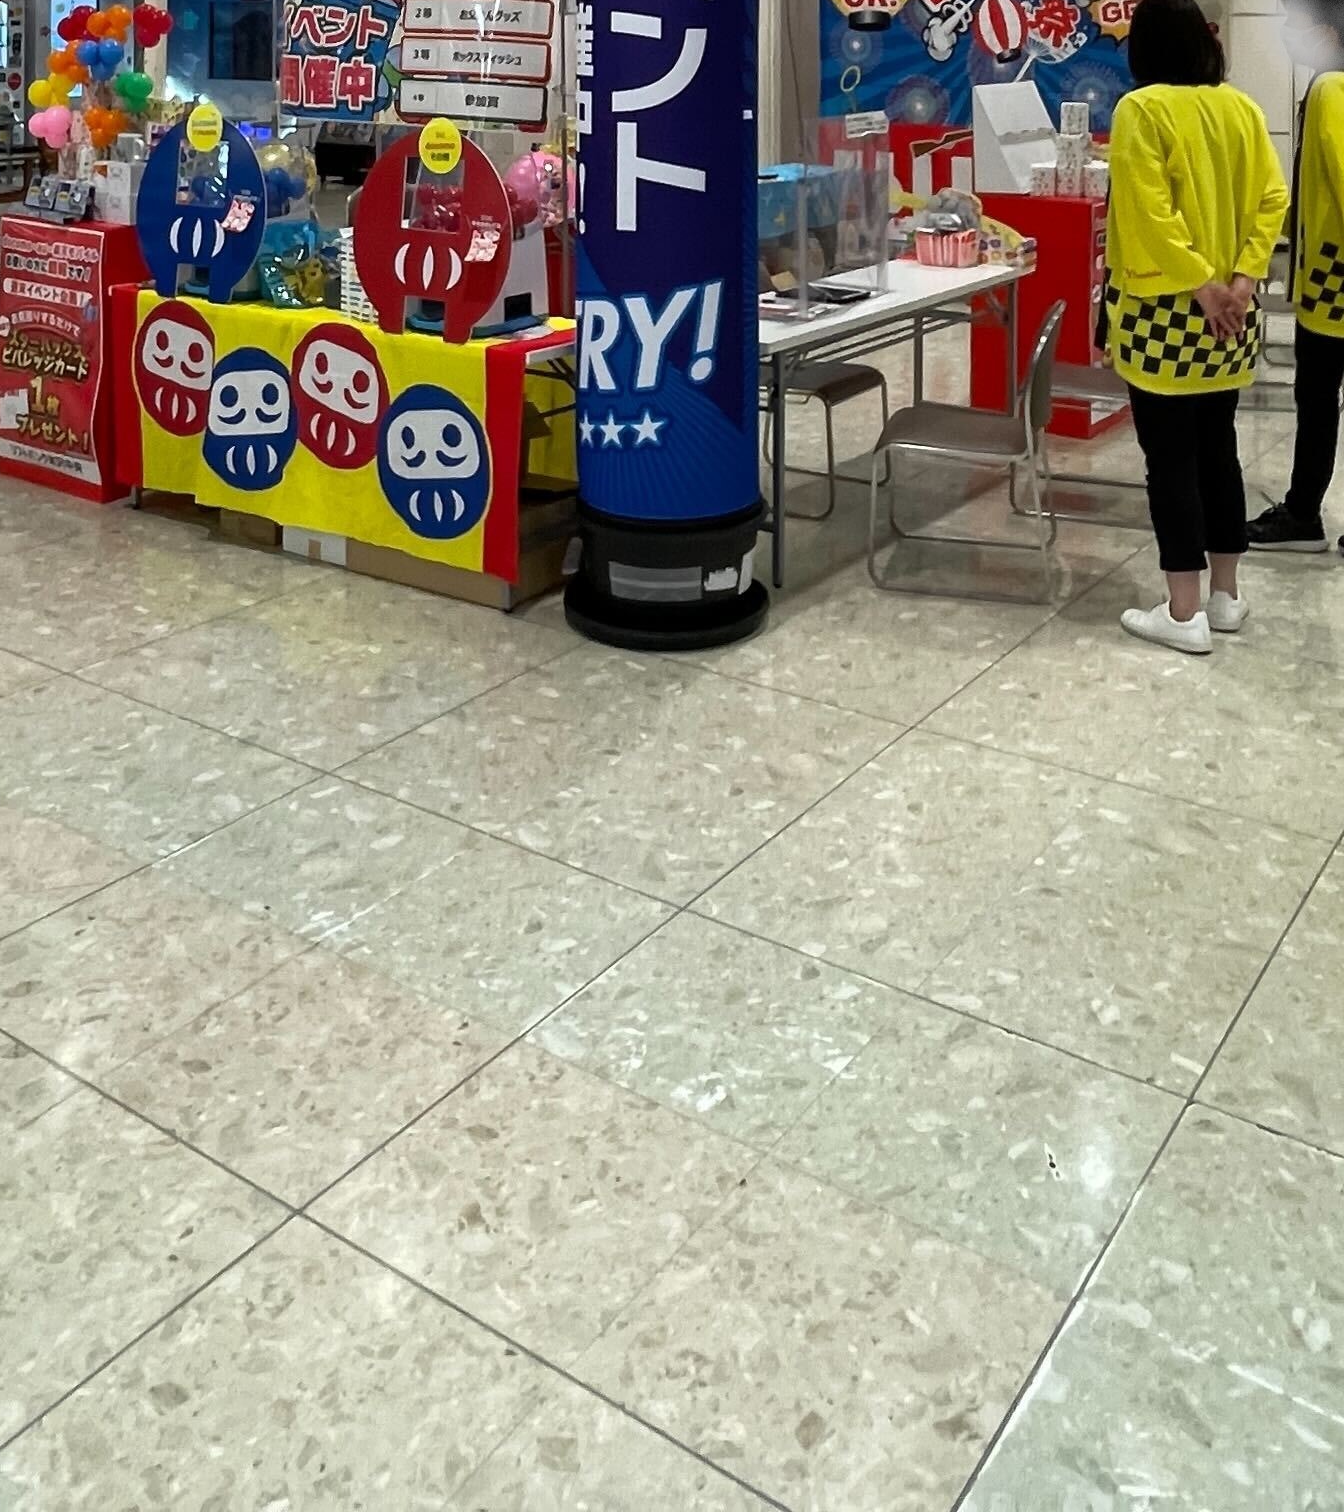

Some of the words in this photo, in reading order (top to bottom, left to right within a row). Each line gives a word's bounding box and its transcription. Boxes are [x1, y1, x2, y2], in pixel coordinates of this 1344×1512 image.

[459, 9, 523, 24] お父んグッズ
[576, 280, 725, 391] RY!
